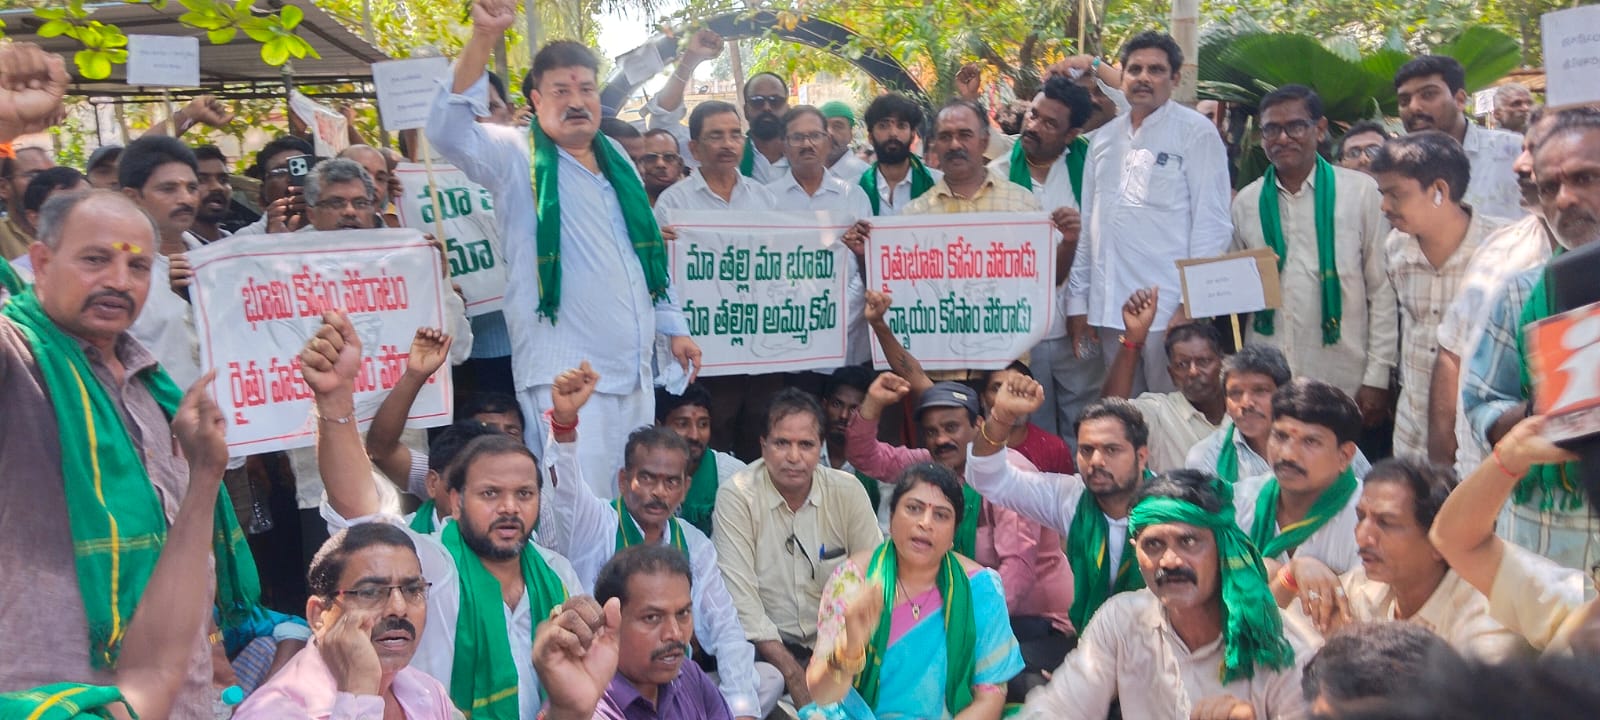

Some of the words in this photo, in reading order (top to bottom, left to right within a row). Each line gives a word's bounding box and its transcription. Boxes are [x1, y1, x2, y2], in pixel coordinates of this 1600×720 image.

[686, 243, 714, 281] మా
[719, 245, 750, 293] తల్లి
[755, 245, 782, 281] మా
[947, 235, 983, 278] కోసం
[241, 276, 294, 331] భూమి
[682, 299, 710, 337] మా
[714, 298, 759, 347] తల్లిని
